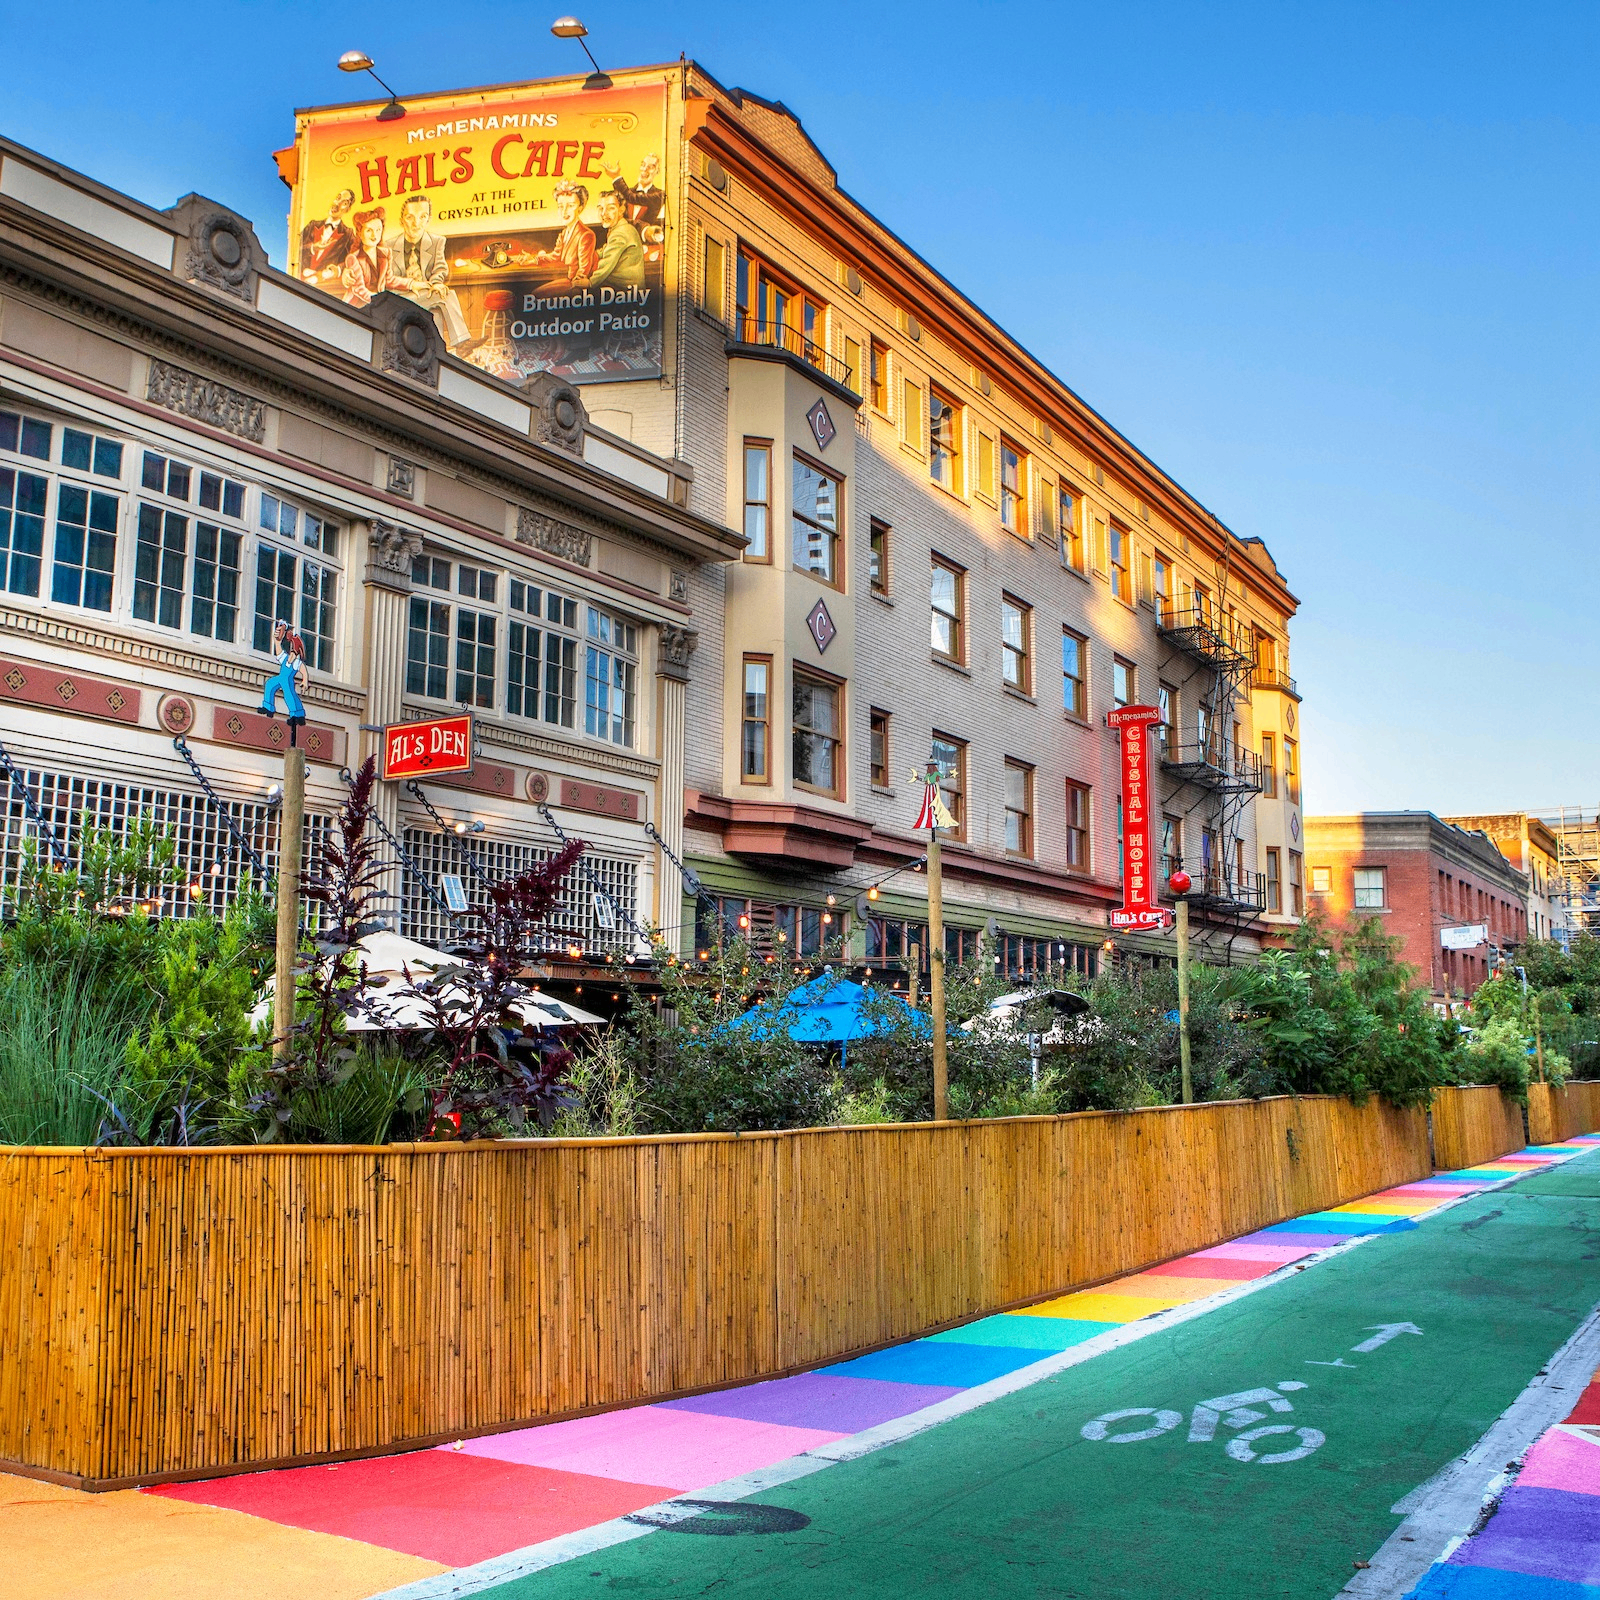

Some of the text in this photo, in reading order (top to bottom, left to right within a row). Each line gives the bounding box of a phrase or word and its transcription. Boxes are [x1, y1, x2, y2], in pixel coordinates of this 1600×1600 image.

[407, 113, 558, 144] McMENAMINS
[356, 133, 606, 204] HAL'S CAFE
[438, 199, 547, 220] CRYSTAL HOTEL
[471, 188, 516, 203] AT THE
[523, 284, 651, 312] Brunch Daily
[510, 310, 650, 339] Outdoor Patio
[389, 726, 466, 766] AL'S DEN
[1126, 726, 1143, 823] CRYSTAL
[1129, 834, 1144, 903] HOTEL
